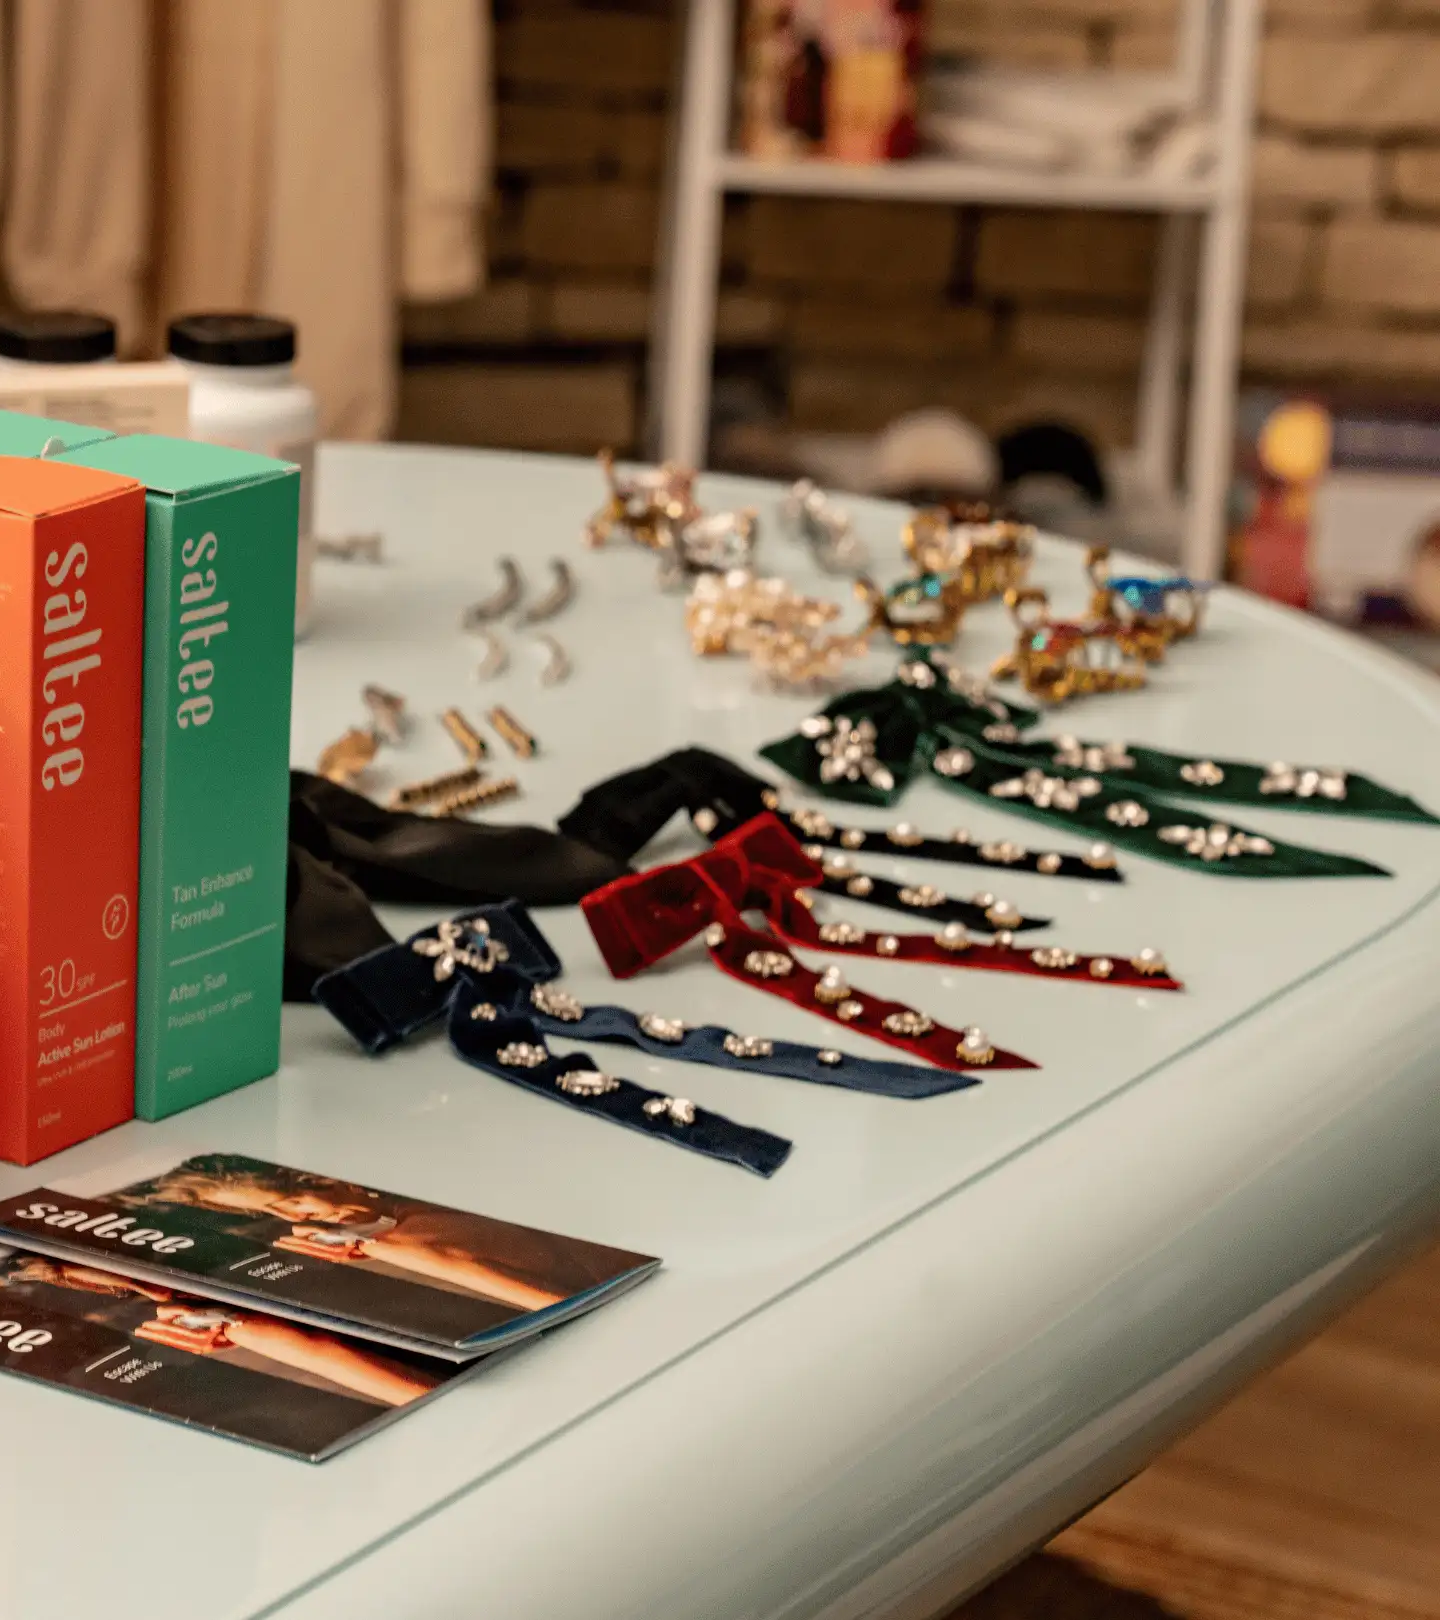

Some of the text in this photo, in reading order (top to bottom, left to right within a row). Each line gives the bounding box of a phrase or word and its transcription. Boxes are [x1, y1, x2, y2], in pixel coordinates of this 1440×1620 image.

[177, 532, 228, 729] saltee
[42, 542, 102, 791] saltee
[172, 864, 254, 904] Tan Enhance
[171, 901, 225, 932] Formula
[39, 958, 76, 1006] 30
[168, 972, 228, 1005] After Sun
[38, 1022, 66, 1044] Body
[38, 1022, 126, 1068] Active Sun Lotion
[16, 1202, 195, 1253] saltee
